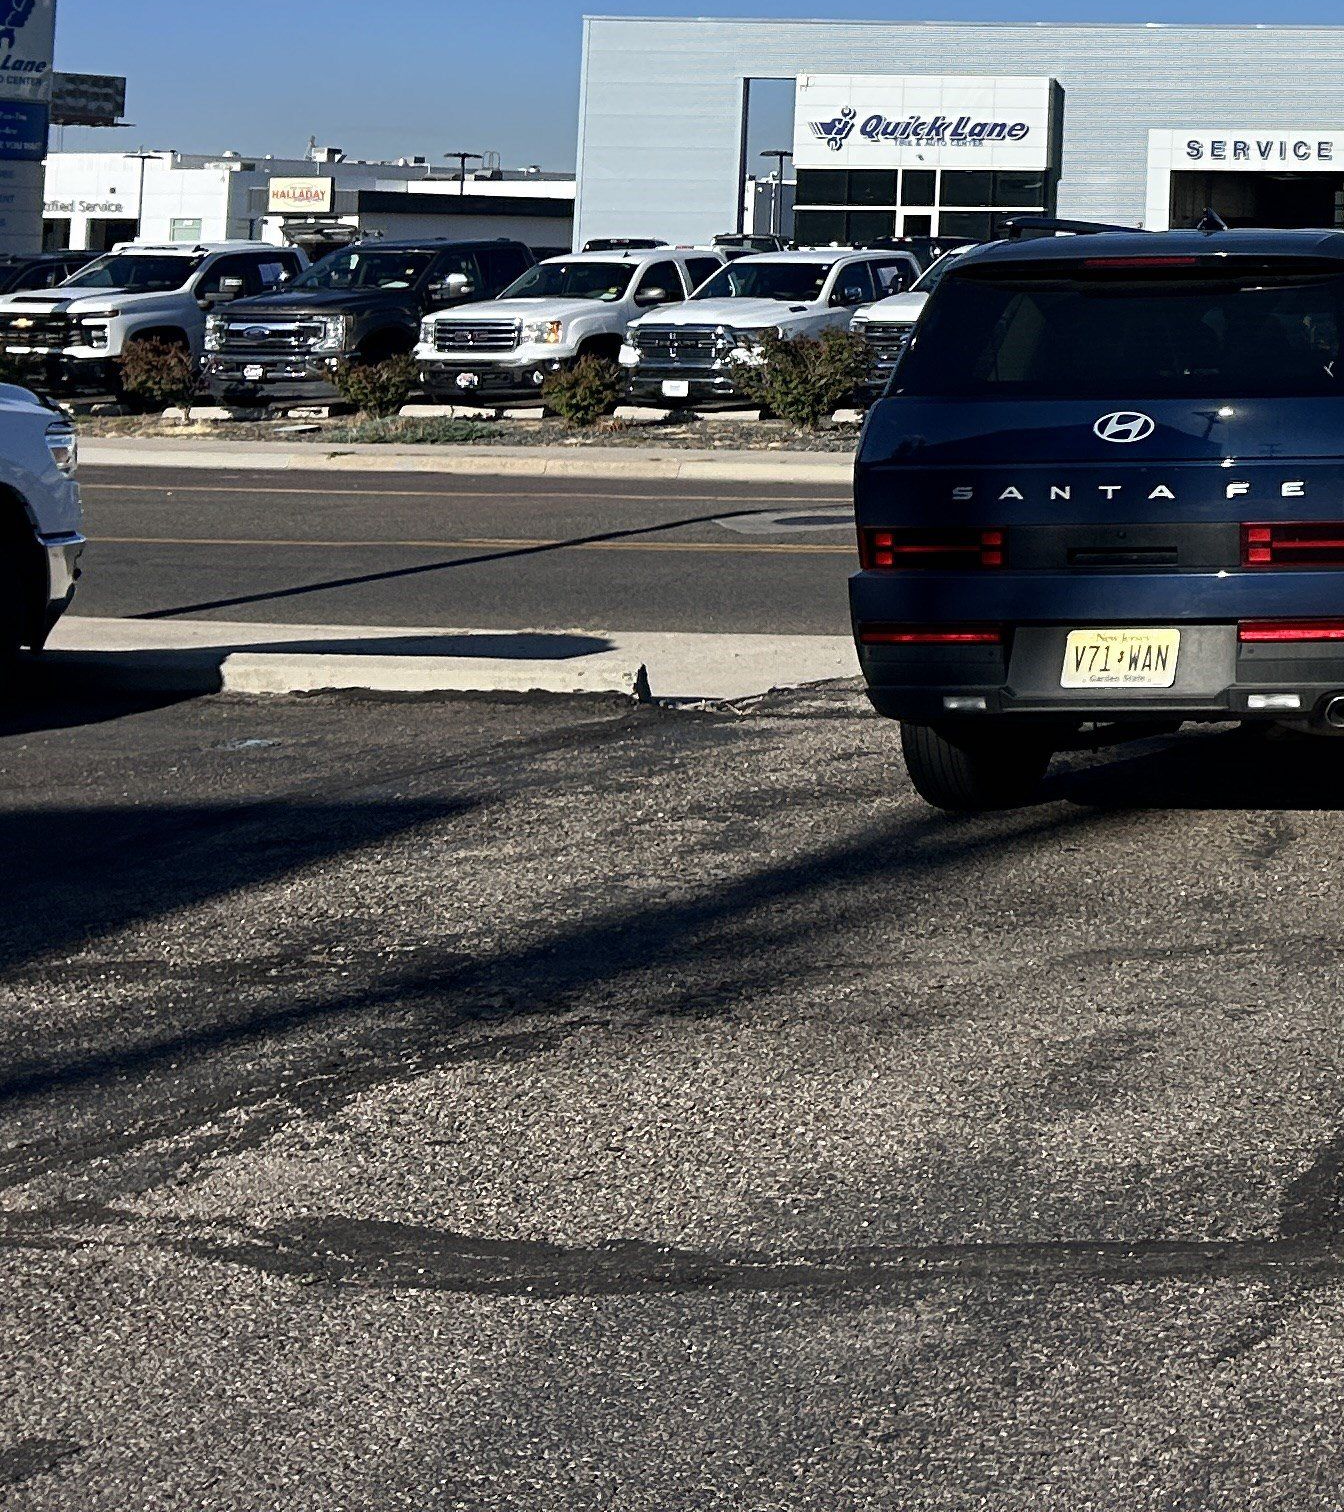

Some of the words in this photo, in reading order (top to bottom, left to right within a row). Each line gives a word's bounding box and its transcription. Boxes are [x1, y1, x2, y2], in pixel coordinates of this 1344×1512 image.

[1, 54, 47, 73] Lane
[859, 114, 952, 140] Quick
[949, 116, 1029, 140] Lane
[1186, 139, 1334, 161] SERVICE
[271, 189, 326, 201] HALLADAY
[79, 200, 123, 213] Service
[952, 484, 1176, 500] SANTA
[1226, 481, 1305, 499] FE
